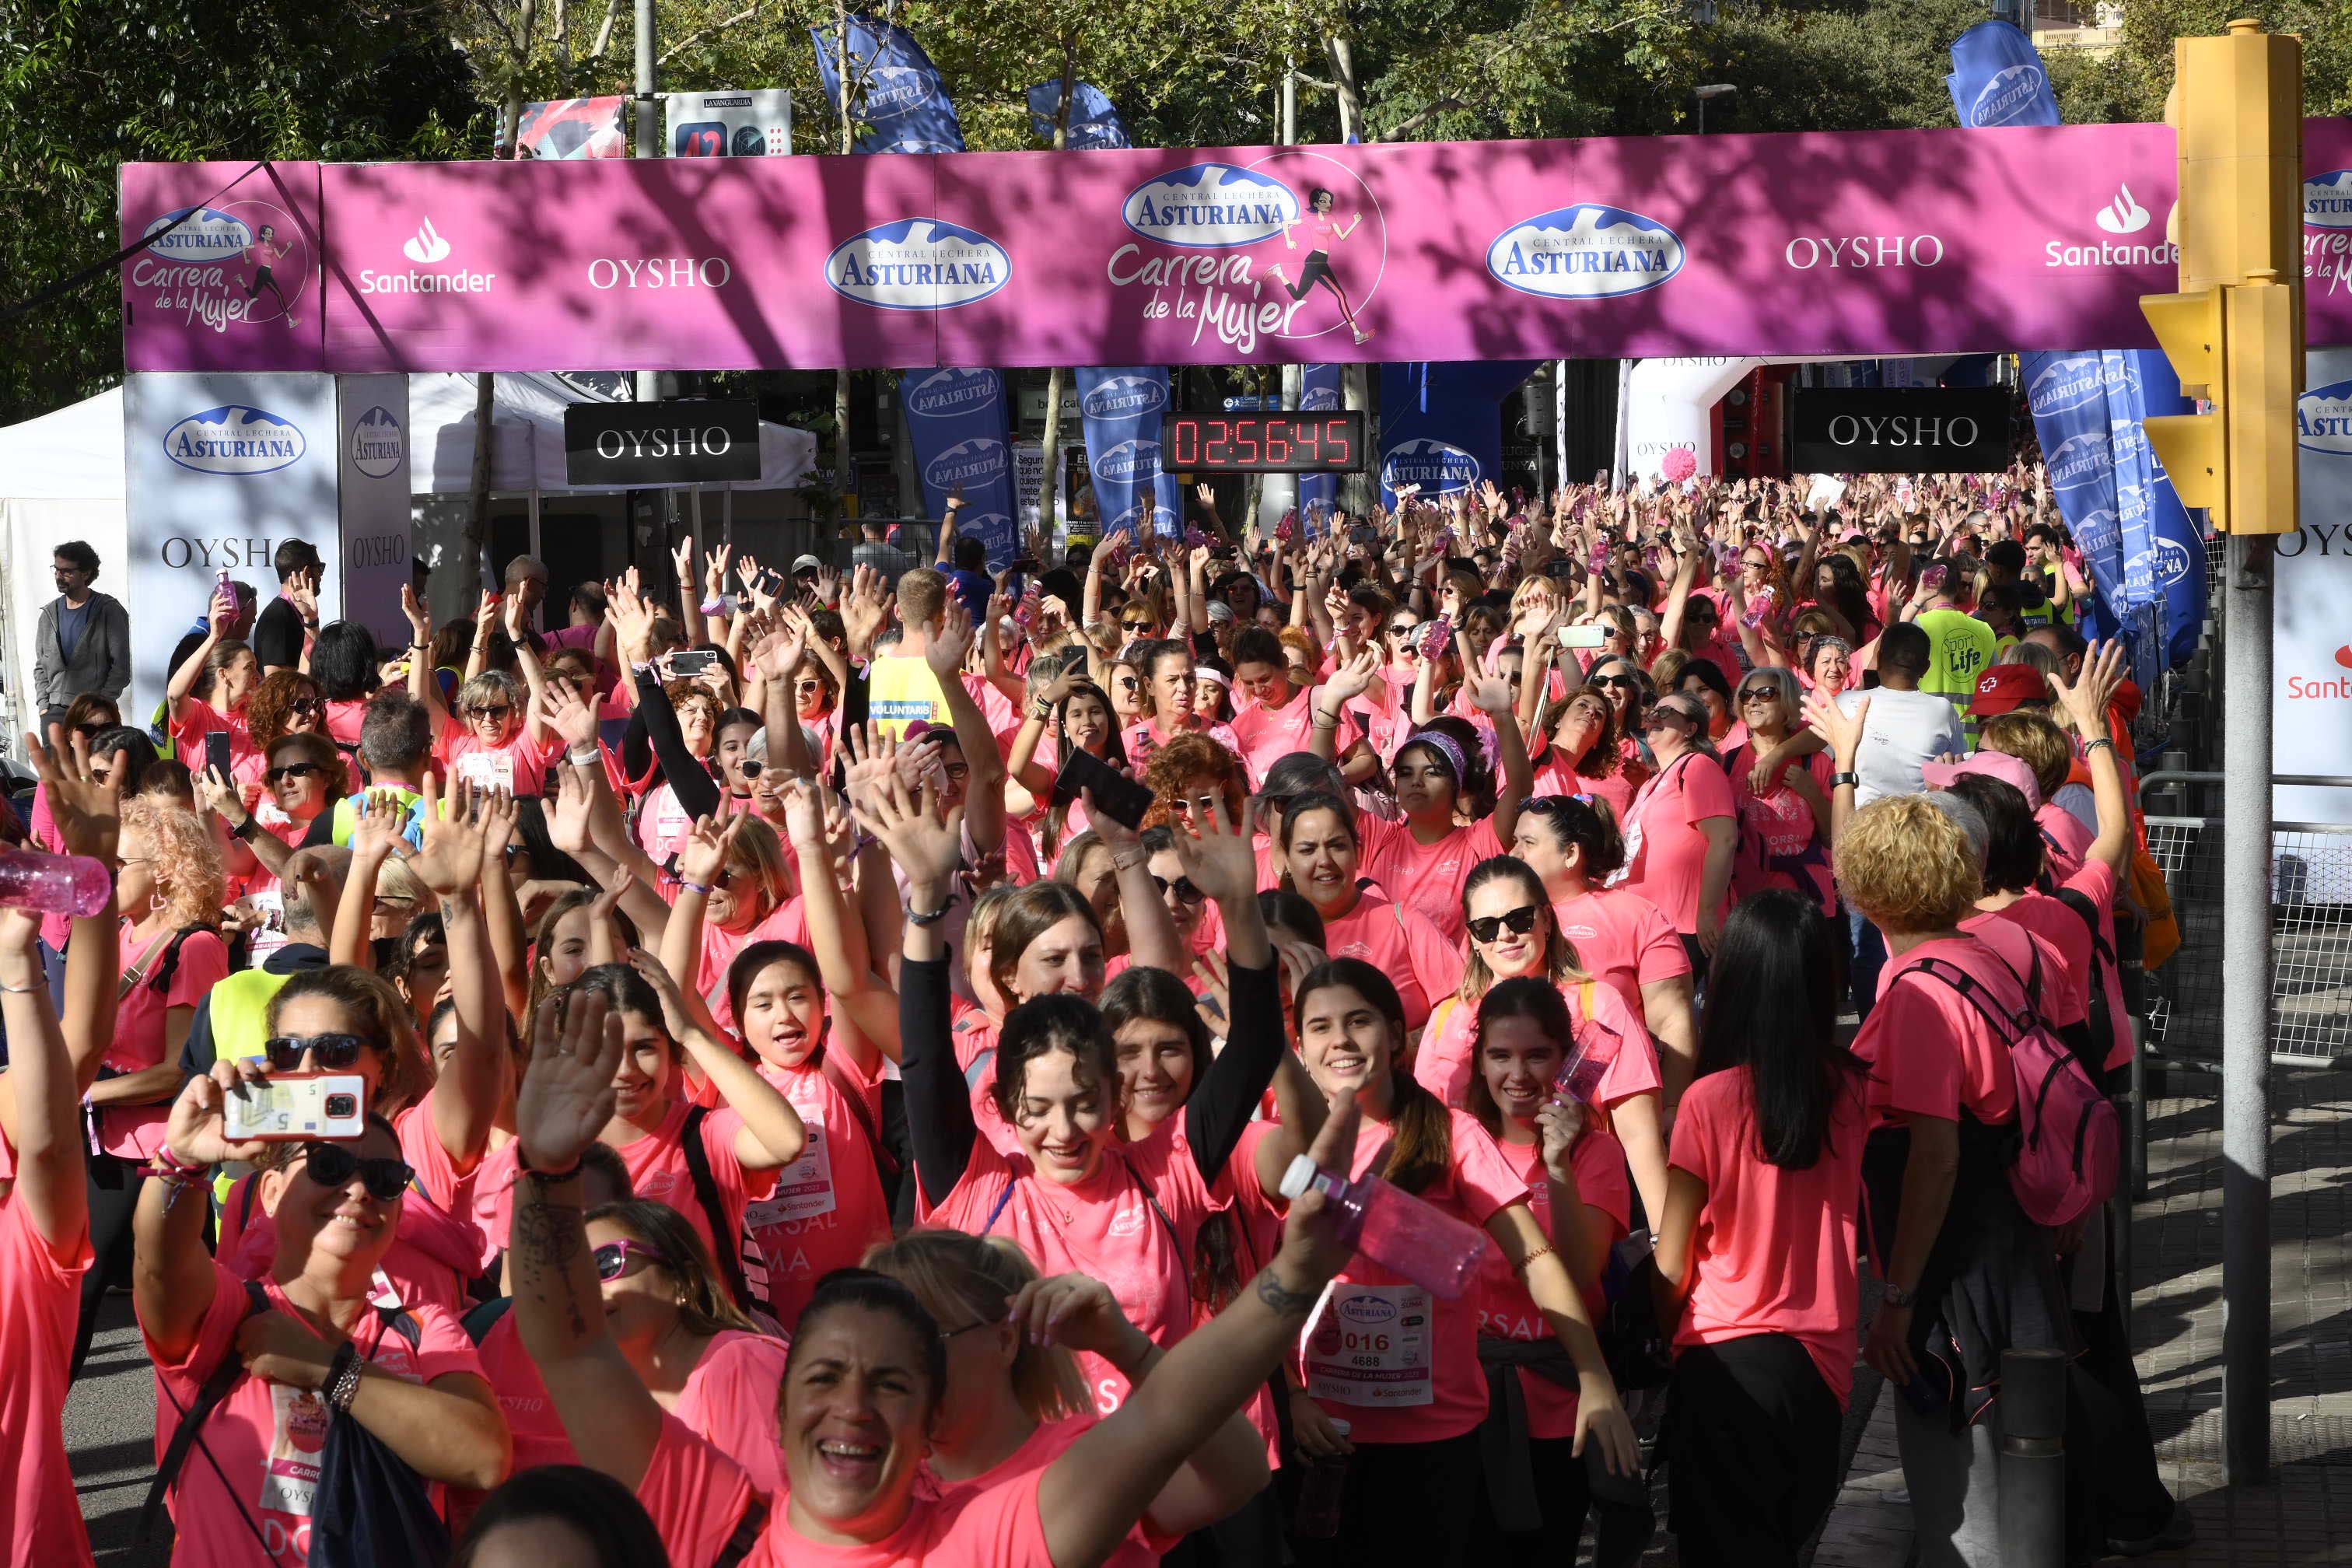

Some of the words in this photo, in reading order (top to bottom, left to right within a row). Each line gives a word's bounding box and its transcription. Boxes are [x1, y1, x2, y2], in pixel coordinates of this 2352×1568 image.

[1136, 194, 1285, 226] ASTURIANA
[152, 227, 244, 248] ASTURIANA
[1533, 237, 1594, 247] CENTRAL
[1599, 236, 1663, 245] LECHERA
[2304, 233, 2352, 255] rre
[868, 250, 927, 259] CENTRAL
[933, 249, 990, 258] LECHERA
[1502, 240, 1669, 275] ASTURIANA
[1785, 234, 1944, 269] OYSHO
[132, 258, 224, 287] Carrera
[587, 257, 731, 289] OYSHO
[839, 252, 996, 286] ASTURIANA
[1107, 243, 1252, 286] Carrera
[2318, 256, 2332, 278] la
[360, 268, 496, 294] Santander
[156, 292, 172, 309] de
[176, 289, 188, 309] la
[186, 285, 258, 333] Mujer
[1143, 289, 1170, 319] de
[1176, 287, 1195, 319] la
[1191, 280, 1307, 355] Mujer
[597, 426, 731, 460] OYSHO
[1175, 421, 1349, 463] 02:56:45
[1829, 415, 1979, 447] OYSHO
[174, 431, 296, 457] ASTURIANA
[355, 433, 400, 461] ASTURIANA
[1020, 468, 1032, 477] que
[1020, 477, 1044, 487] quiere
[1384, 462, 1471, 483] ASTURIANA
[161, 537, 305, 569] OYSH
[353, 534, 404, 569] OYSHO
[1944, 635, 1975, 654] Sport
[1950, 648, 1981, 674] Life
[870, 705, 929, 715] VOLUNTARIS
[278, 1113, 289, 1130] 5
[777, 1187, 801, 1195] MUJER
[788, 1199, 825, 1212] Santander
[752, 1212, 837, 1236] RSAL
[1344, 1304, 1392, 1317] ASTURIANA
[1345, 1332, 1389, 1350] 016
[1320, 1367, 1350, 1377] CARRERA
[1352, 1356, 1380, 1367] 4688
[1318, 1381, 1351, 1395] OYSHO
[1381, 1388, 1422, 1398] Santander
